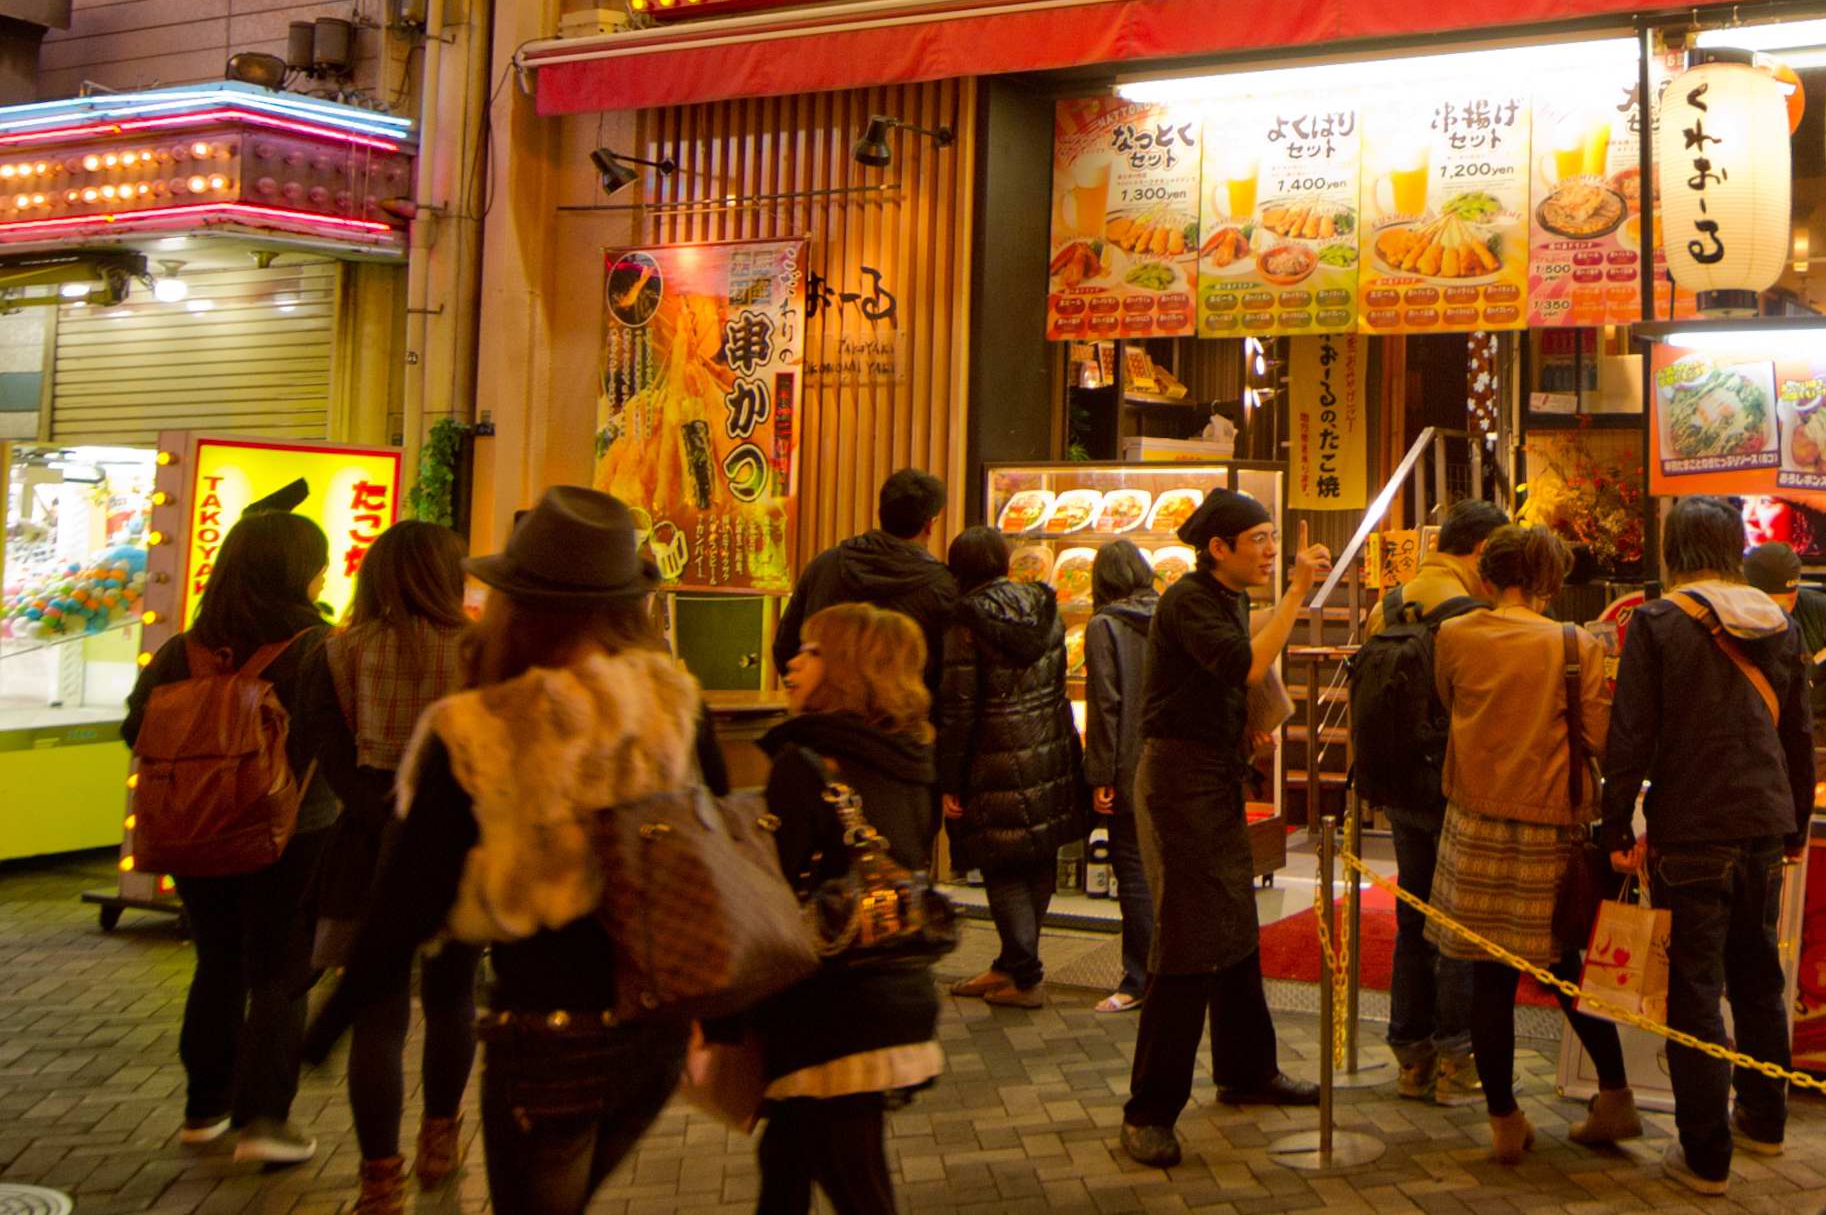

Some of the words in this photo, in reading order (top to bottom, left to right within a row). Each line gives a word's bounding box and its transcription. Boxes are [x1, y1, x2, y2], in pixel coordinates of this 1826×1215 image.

[1111, 122, 1195, 153] なっとく
[1287, 139, 1336, 159] セット
[1448, 128, 1502, 150] セット
[1130, 148, 1177, 170] セット
[1683, 82, 1730, 265] くれおーる
[723, 311, 775, 502] 串かつ
